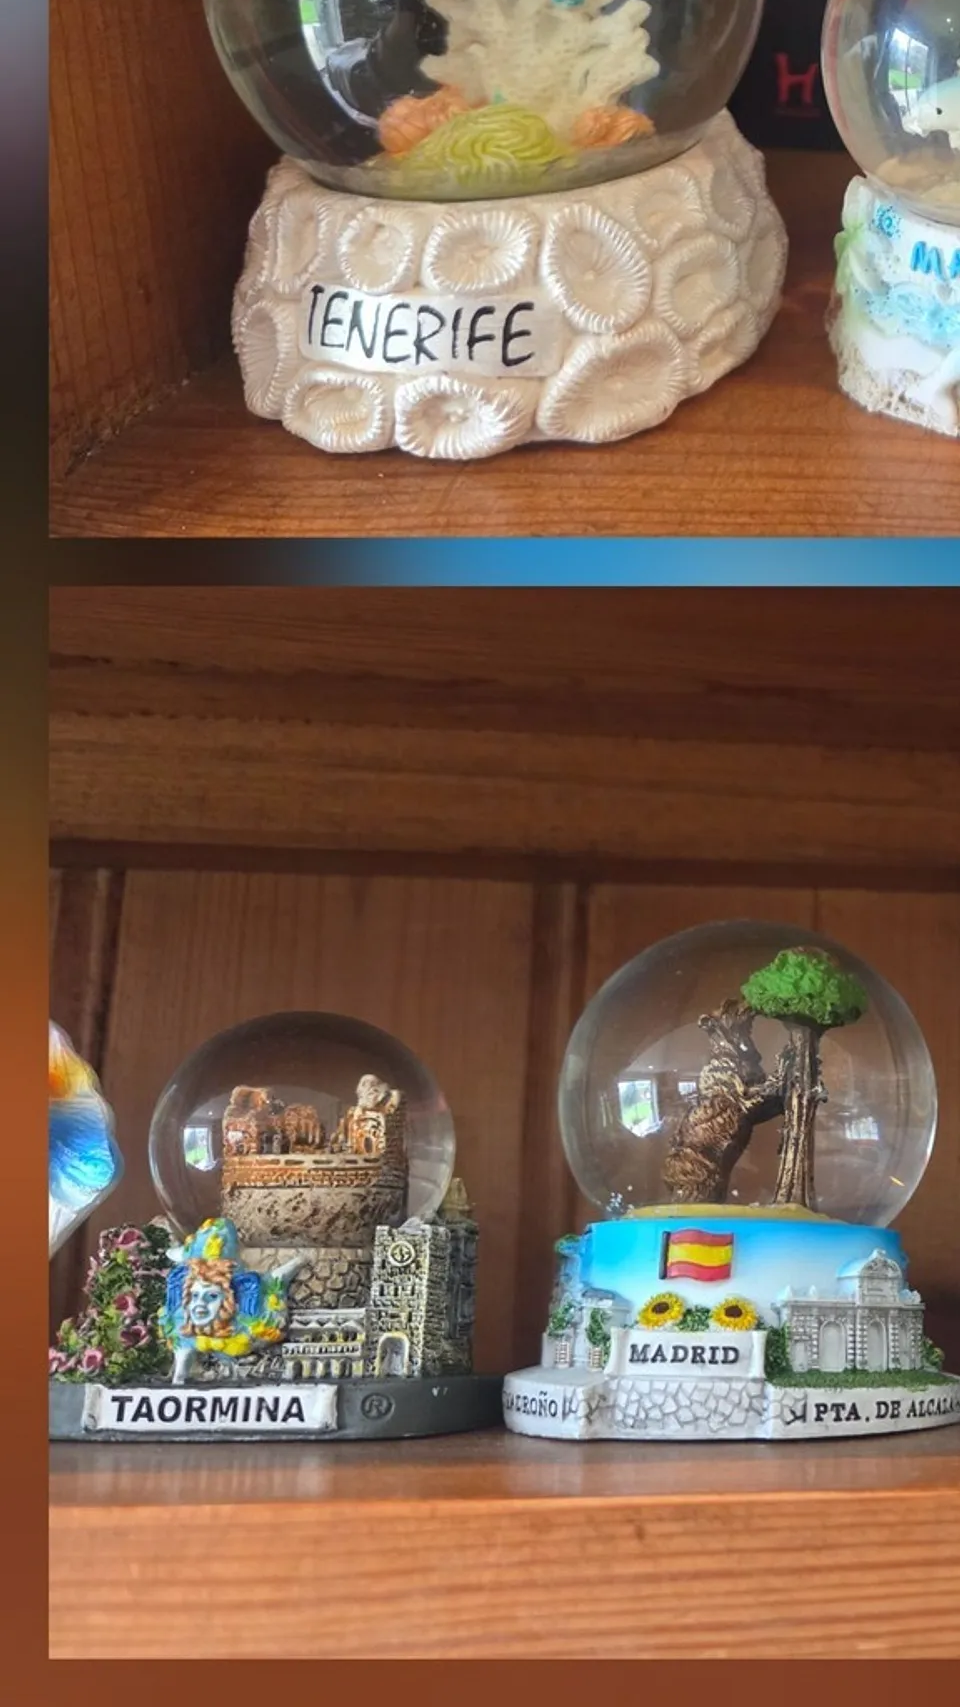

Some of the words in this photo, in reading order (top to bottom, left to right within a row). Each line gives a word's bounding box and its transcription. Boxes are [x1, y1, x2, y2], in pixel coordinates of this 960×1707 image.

[306, 284, 537, 368] TENERIFE
[629, 1343, 741, 1366] MADRID
[110, 1393, 306, 1424] TAORMINA
[876, 1401, 901, 1419] DE
